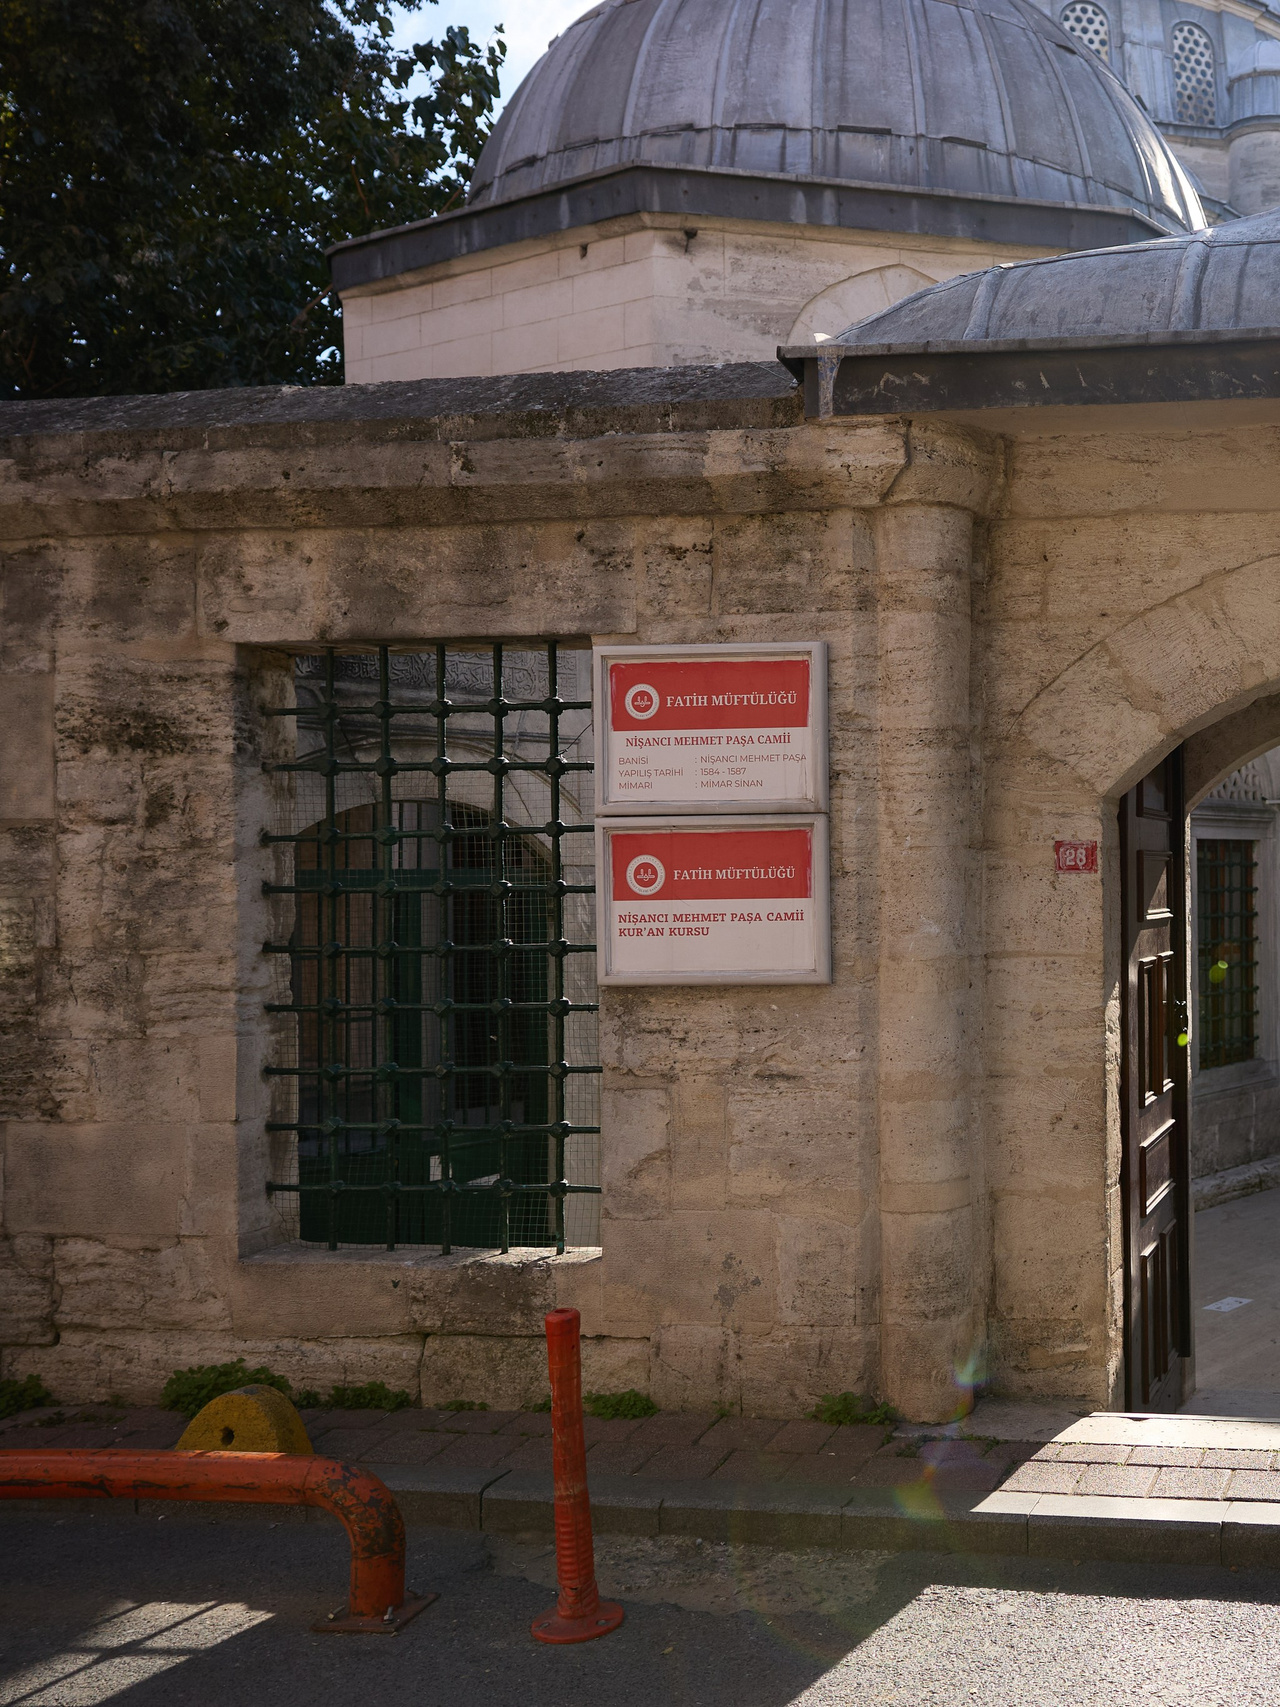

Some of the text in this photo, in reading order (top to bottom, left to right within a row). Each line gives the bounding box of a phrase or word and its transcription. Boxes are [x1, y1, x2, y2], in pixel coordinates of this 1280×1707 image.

[666, 692, 708, 707] FATİH
[711, 690, 798, 707] MÜFTÜLÜĞÜ
[625, 732, 791, 750] NİŞANCI MEHMET PAŞA CAMİİ
[618, 755, 649, 766] BANİSİ
[700, 754, 738, 766] NİŞANCI
[739, 754, 780, 763] MEHMET
[782, 753, 807, 764] PAŞA
[618, 769, 653, 779] YAPILIŞ
[654, 767, 684, 777] TARİHİ
[700, 768, 720, 776] 1584
[727, 767, 747, 776] 1587
[618, 780, 653, 790] MİMARI
[700, 779, 733, 788] MİMAR
[735, 778, 763, 788] SİNAN
[1065, 847, 1087, 867] 28
[673, 865, 796, 880] FATİH MÜFTÜLÜĞÜ
[618, 909, 805, 925] NİŞANCI MEHMET PAŞA CAMİİ
[669, 926, 710, 937] KURSU
